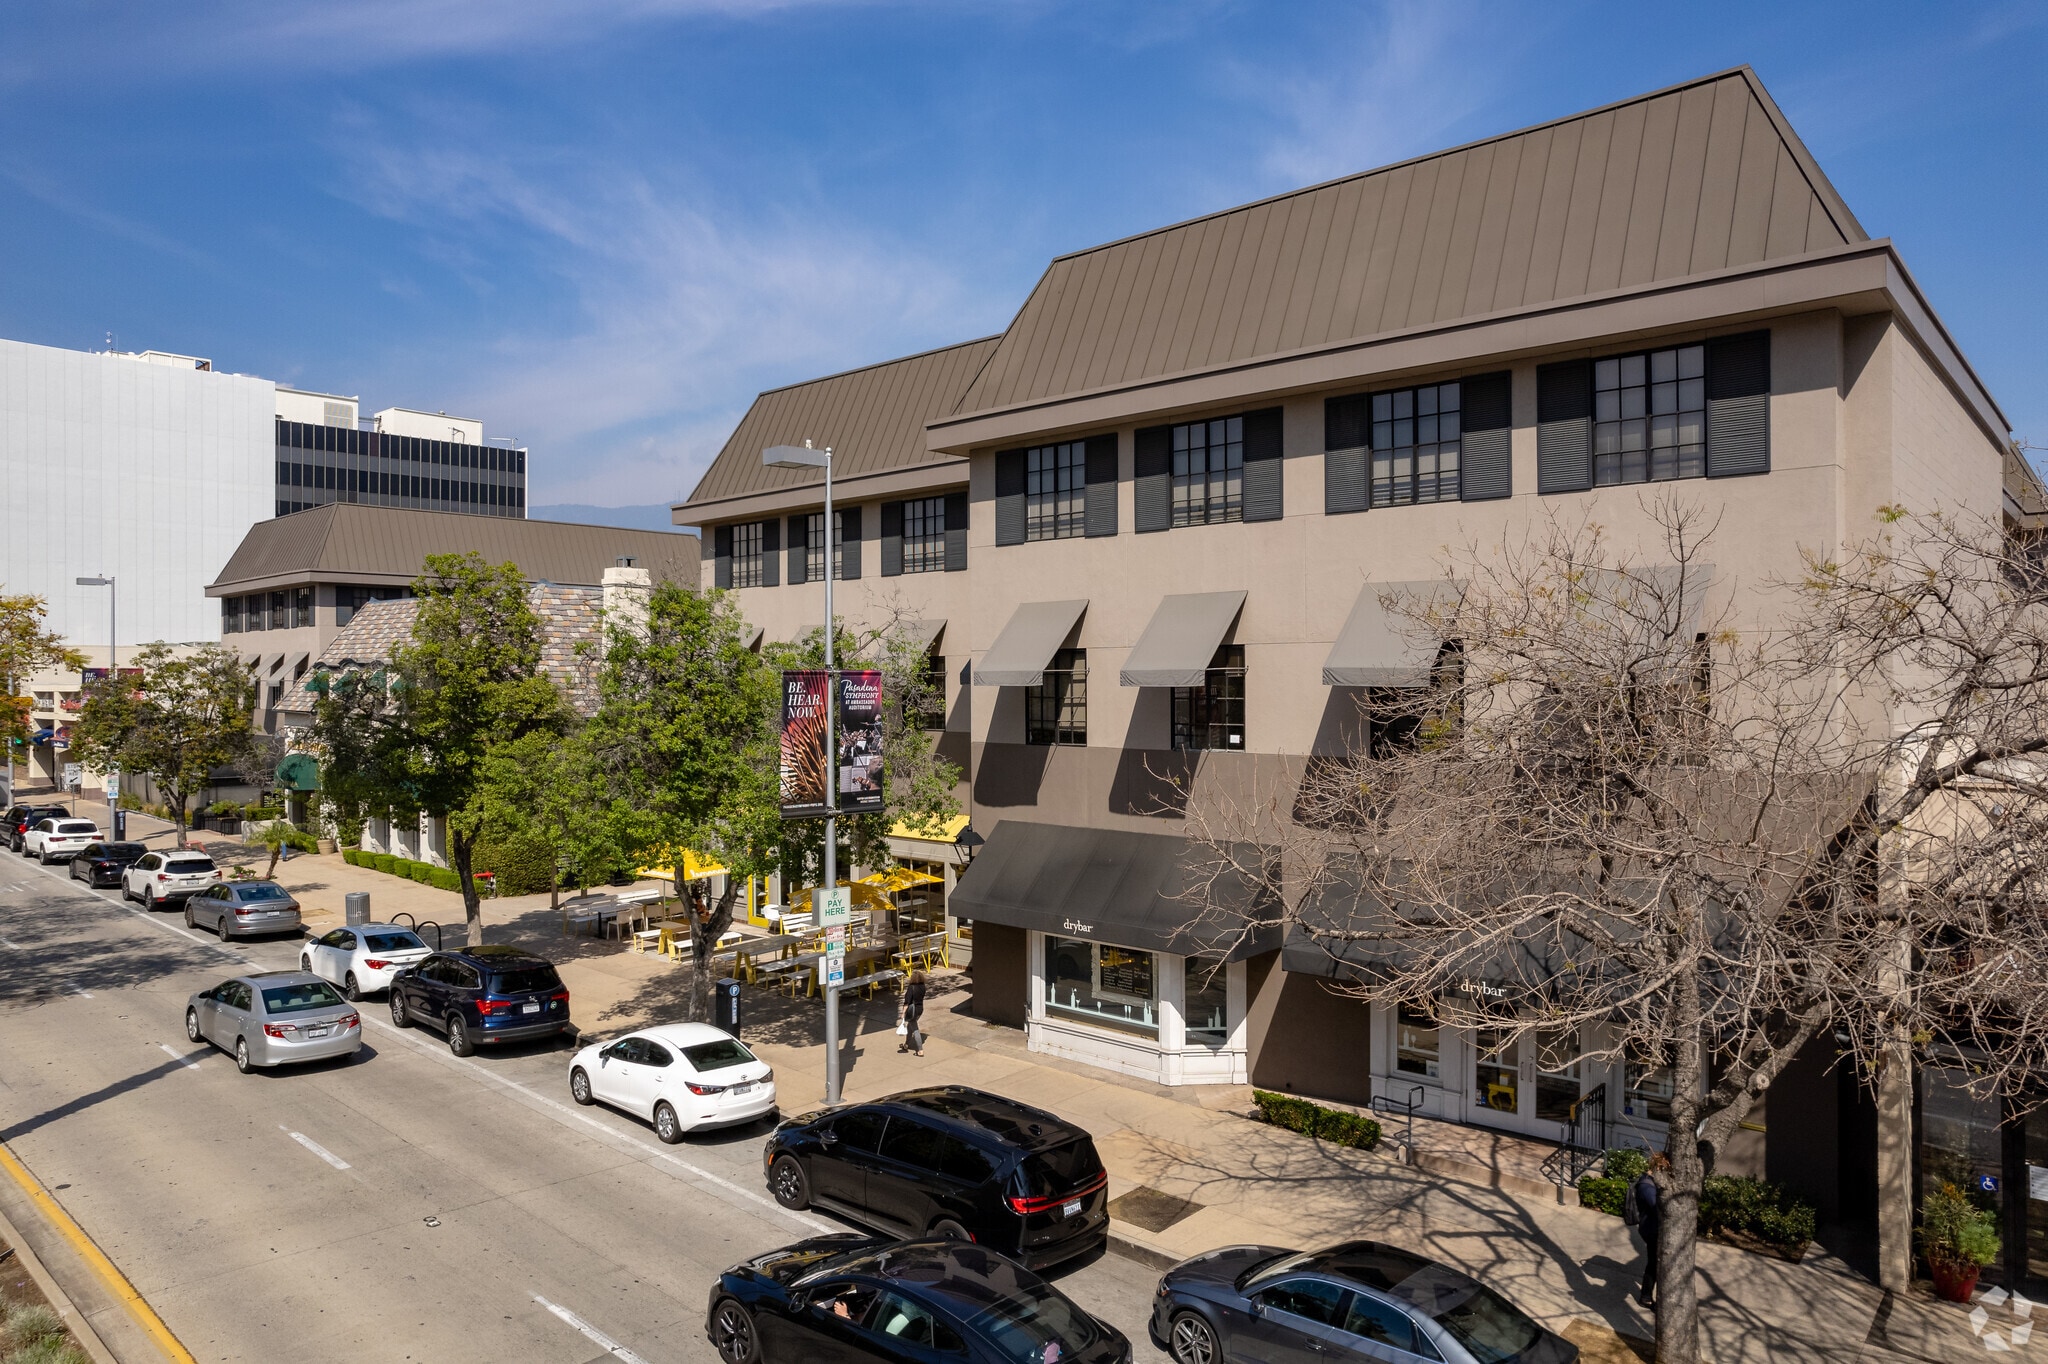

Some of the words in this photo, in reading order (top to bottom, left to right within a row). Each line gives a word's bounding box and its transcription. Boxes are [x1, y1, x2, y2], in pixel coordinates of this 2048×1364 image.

[788, 681, 806, 693] BE.
[841, 679, 879, 695] Pasadena
[788, 694, 823, 706] HEAR.
[788, 706, 817, 719] NOW.
[827, 899, 843, 908] PAY
[825, 907, 846, 917] HERE
[1063, 918, 1092, 935] drybar
[1460, 978, 1505, 999] drybar
